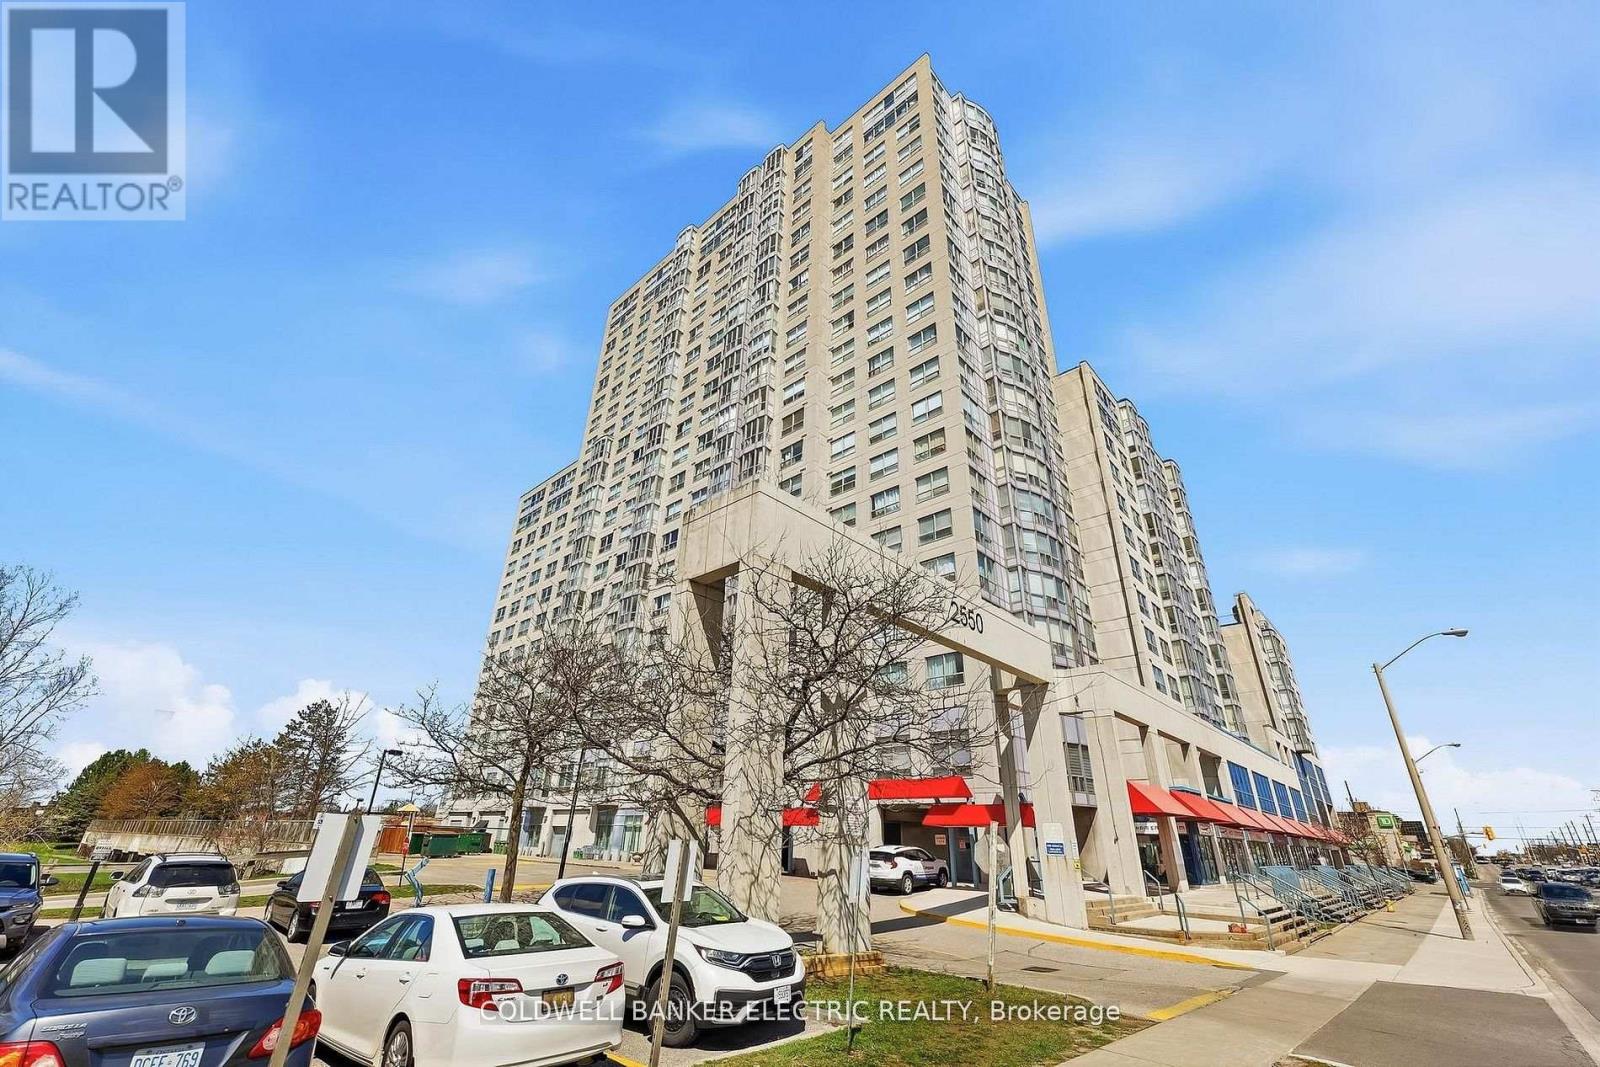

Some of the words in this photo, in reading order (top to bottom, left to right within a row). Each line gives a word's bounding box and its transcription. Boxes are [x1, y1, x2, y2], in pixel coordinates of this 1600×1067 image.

[950, 601, 984, 634] 2550
[1378, 817, 1391, 825] TD
[176, 1051, 199, 1067] 769
